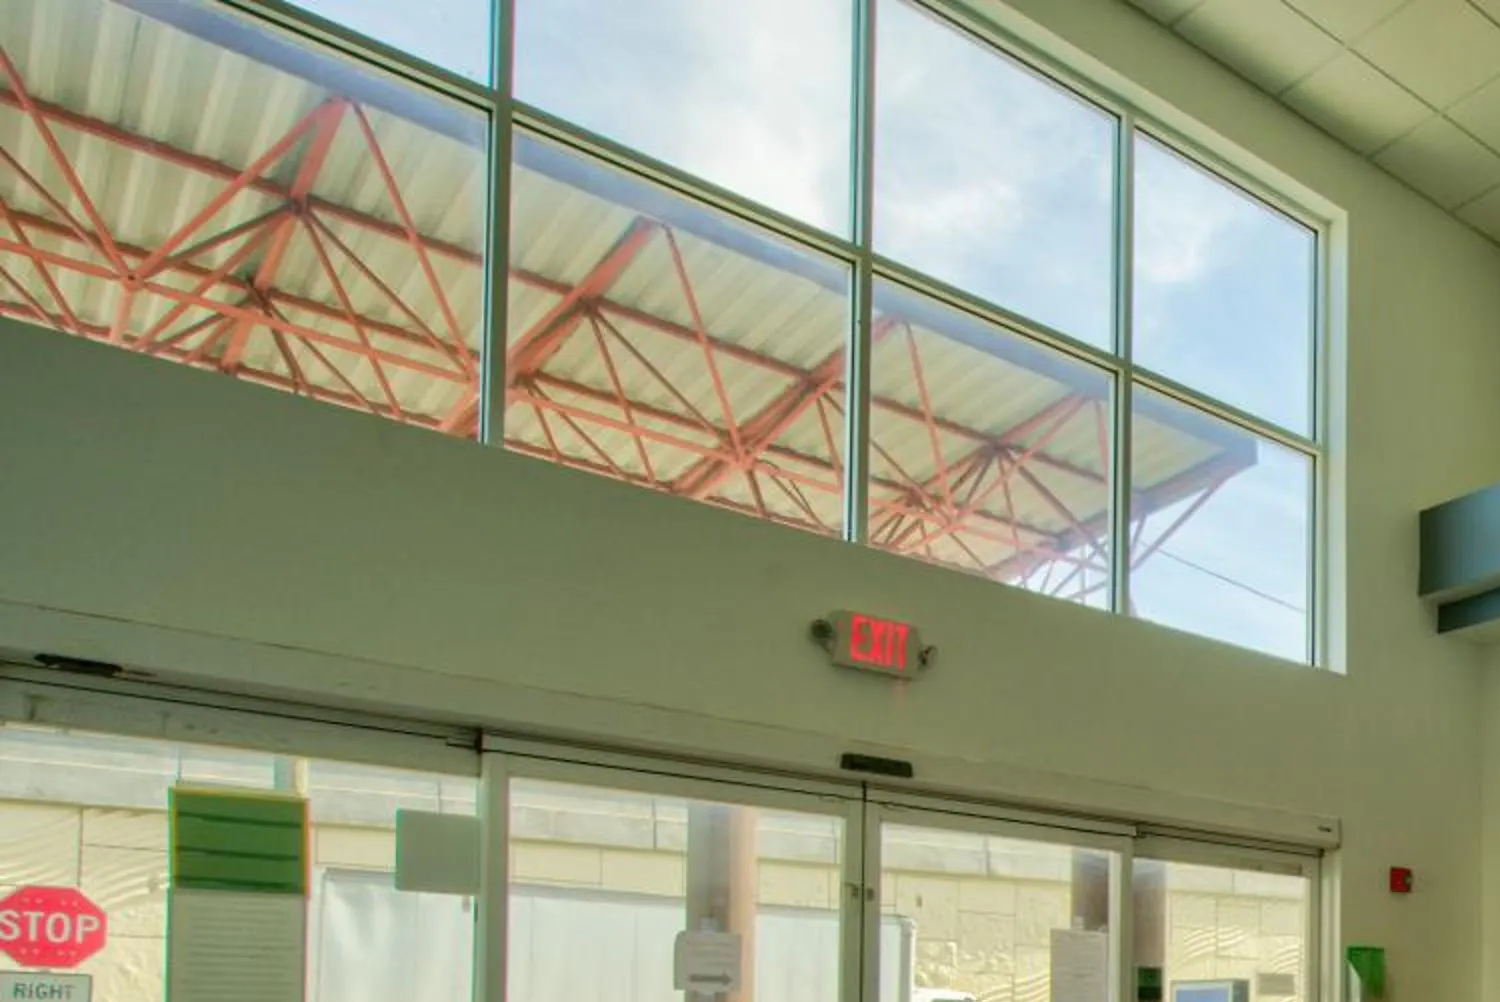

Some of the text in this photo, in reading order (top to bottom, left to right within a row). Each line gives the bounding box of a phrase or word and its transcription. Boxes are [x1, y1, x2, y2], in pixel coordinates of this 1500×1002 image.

[851, 613, 908, 672] EXIT
[0, 909, 100, 944] STOP
[13, 982, 75, 999] RIGHT
